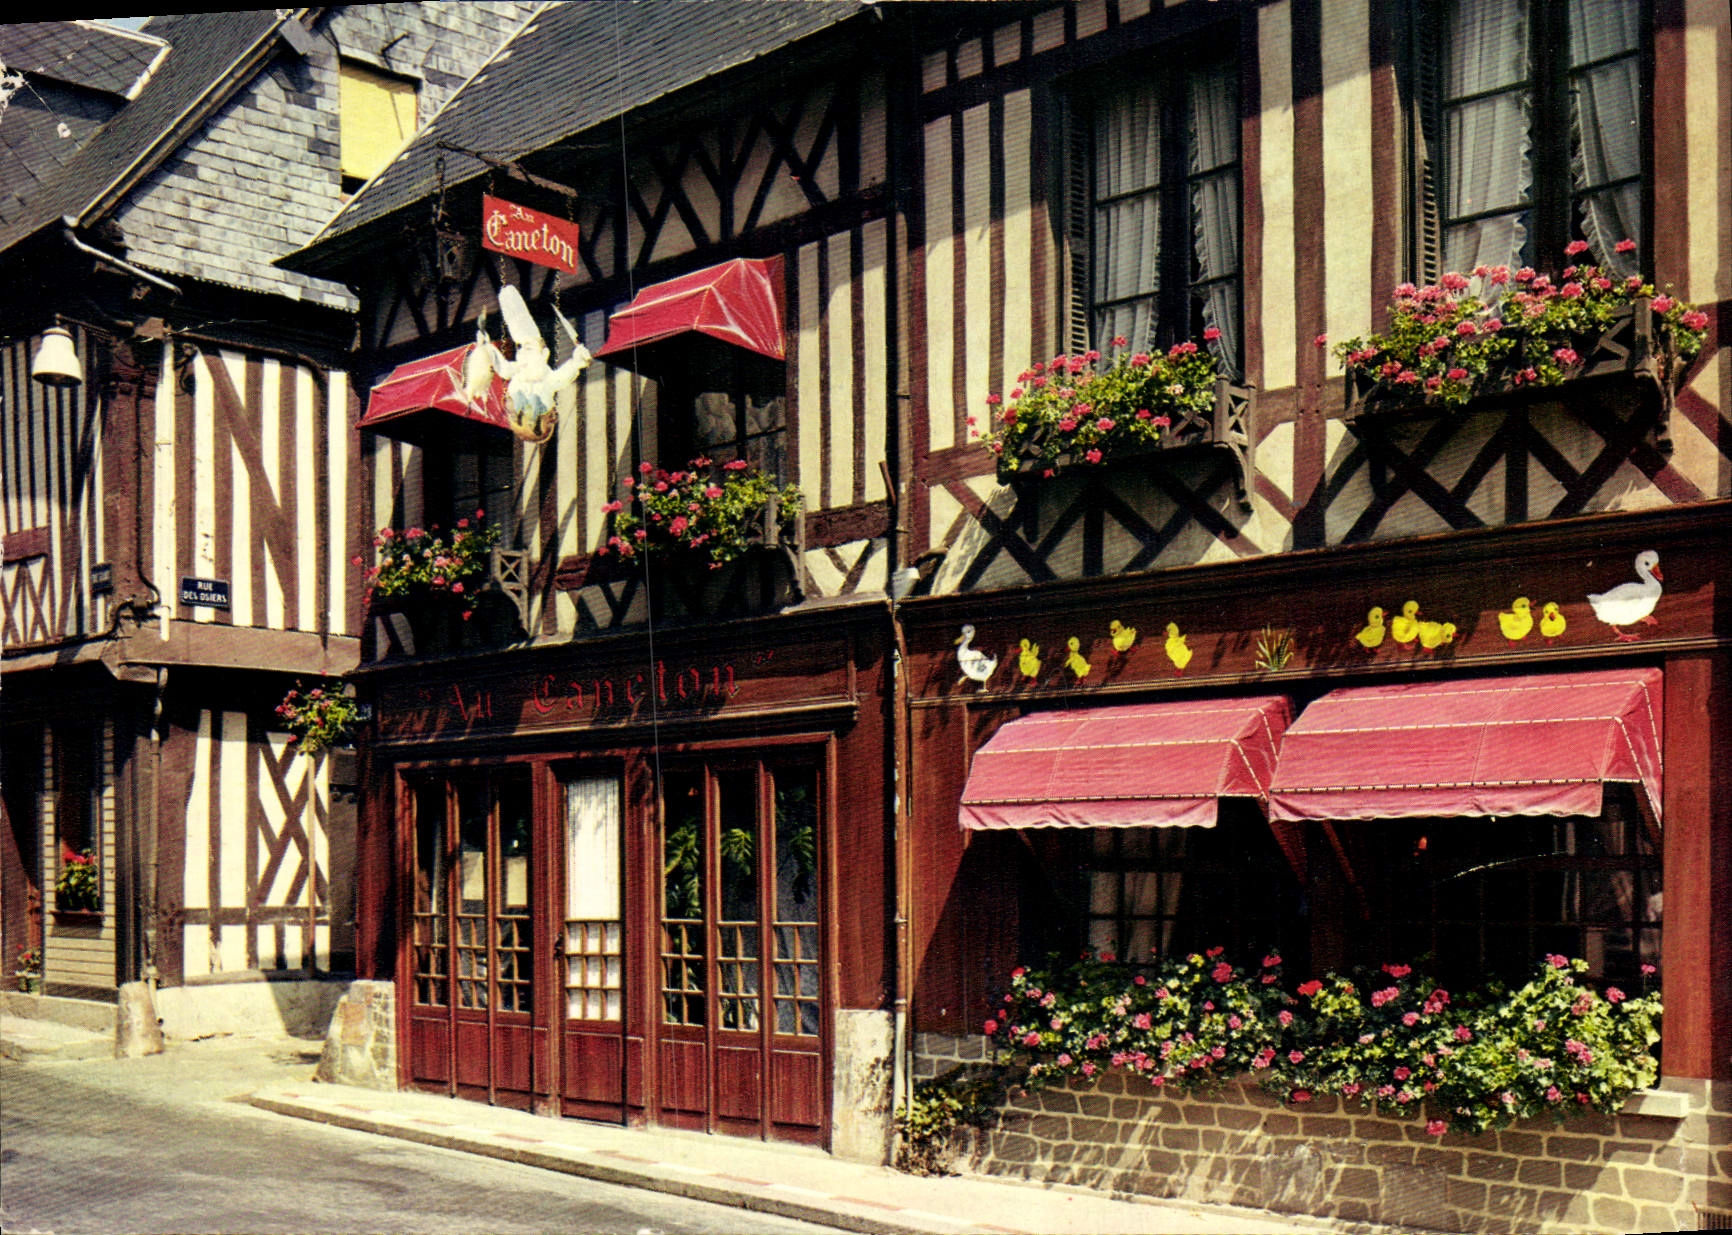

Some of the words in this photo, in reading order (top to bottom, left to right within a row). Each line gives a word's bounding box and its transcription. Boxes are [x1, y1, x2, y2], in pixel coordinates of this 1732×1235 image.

[486, 210, 574, 268] Caneton
[197, 581, 213, 591] RUE
[183, 591, 198, 600] DES
[199, 592, 227, 603] OSIERS
